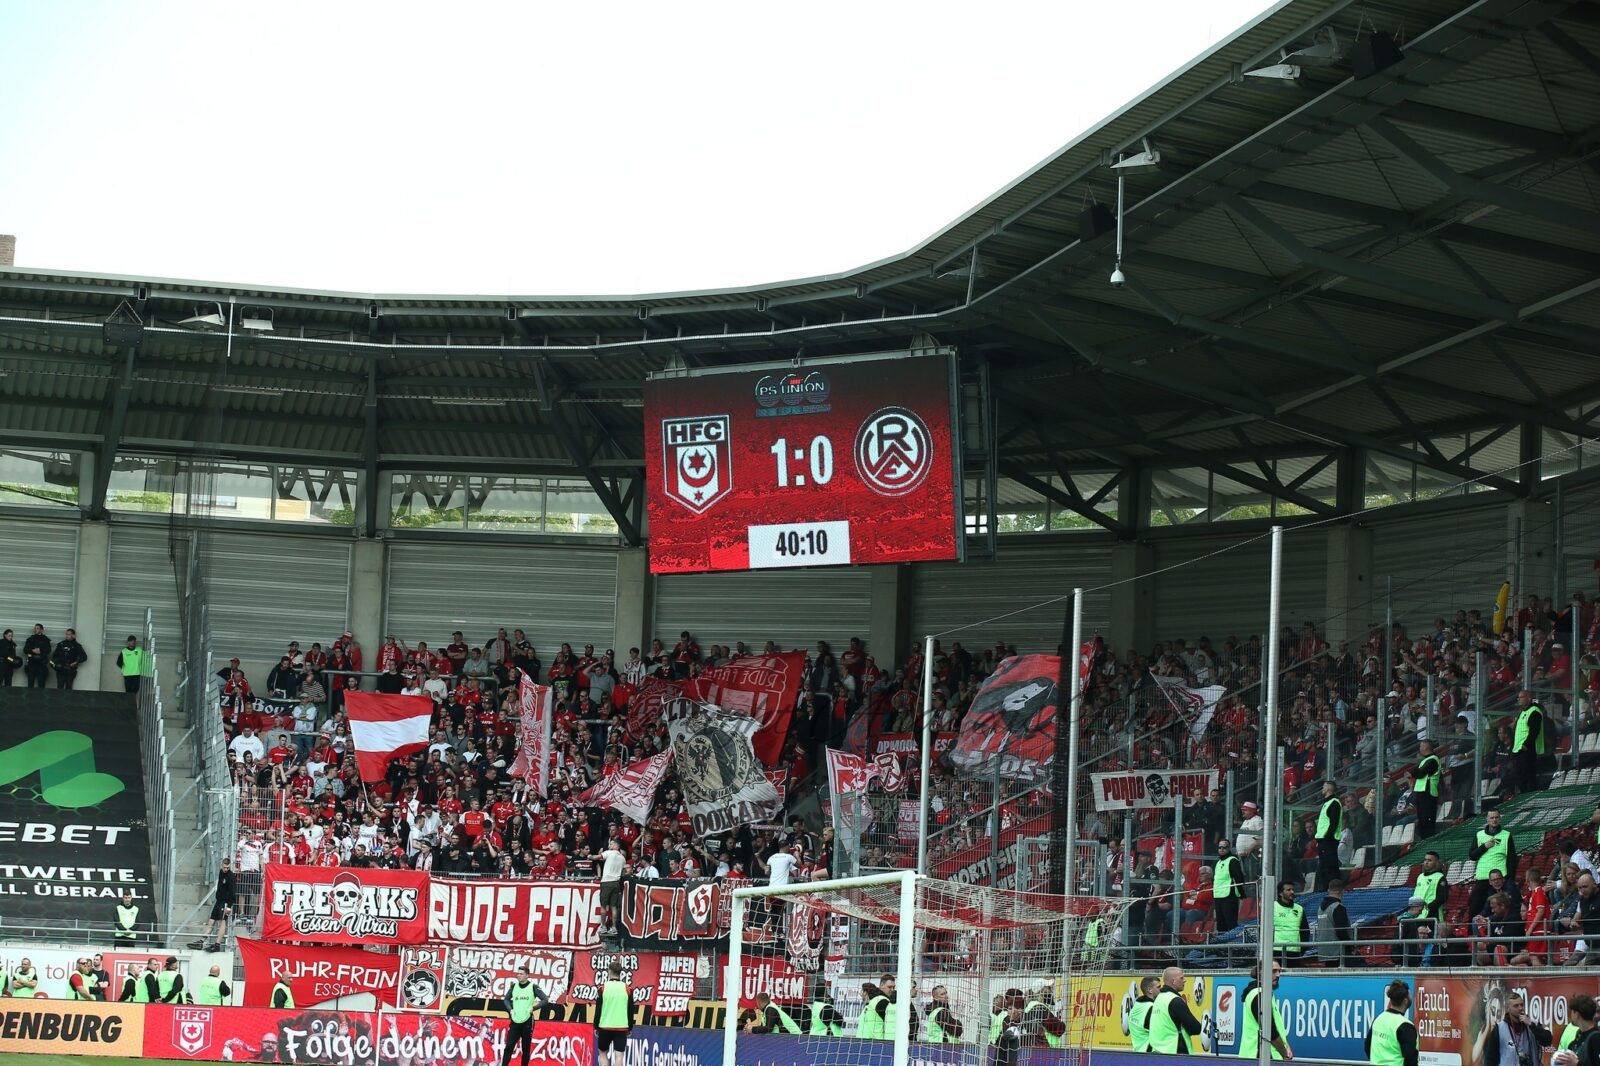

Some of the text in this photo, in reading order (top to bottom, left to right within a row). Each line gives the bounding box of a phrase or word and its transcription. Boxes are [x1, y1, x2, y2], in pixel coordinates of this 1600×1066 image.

[760, 382, 824, 396] PS UNION
[670, 422, 722, 443] HFC
[770, 435, 834, 487] 1:0
[775, 529, 828, 556] 40:10
[272, 881, 417, 919] FREAKS
[293, 910, 398, 937] Essen Ultras
[428, 882, 517, 941] RUDE
[526, 886, 601, 945] FANS
[405, 948, 444, 969] LPL
[459, 949, 566, 978] WRECKING
[660, 956, 695, 973] HAFEN
[658, 973, 694, 992] SÄNGER
[655, 996, 690, 1012] ESSEN
[1418, 986, 1450, 1012] Tauch
[175, 1010, 210, 1022] HFC
[1295, 998, 1376, 1039] BROCKEN
[1418, 1012, 1436, 1037] ein
[282, 1026, 373, 1065] Folge
[384, 1026, 485, 1059] deinem
